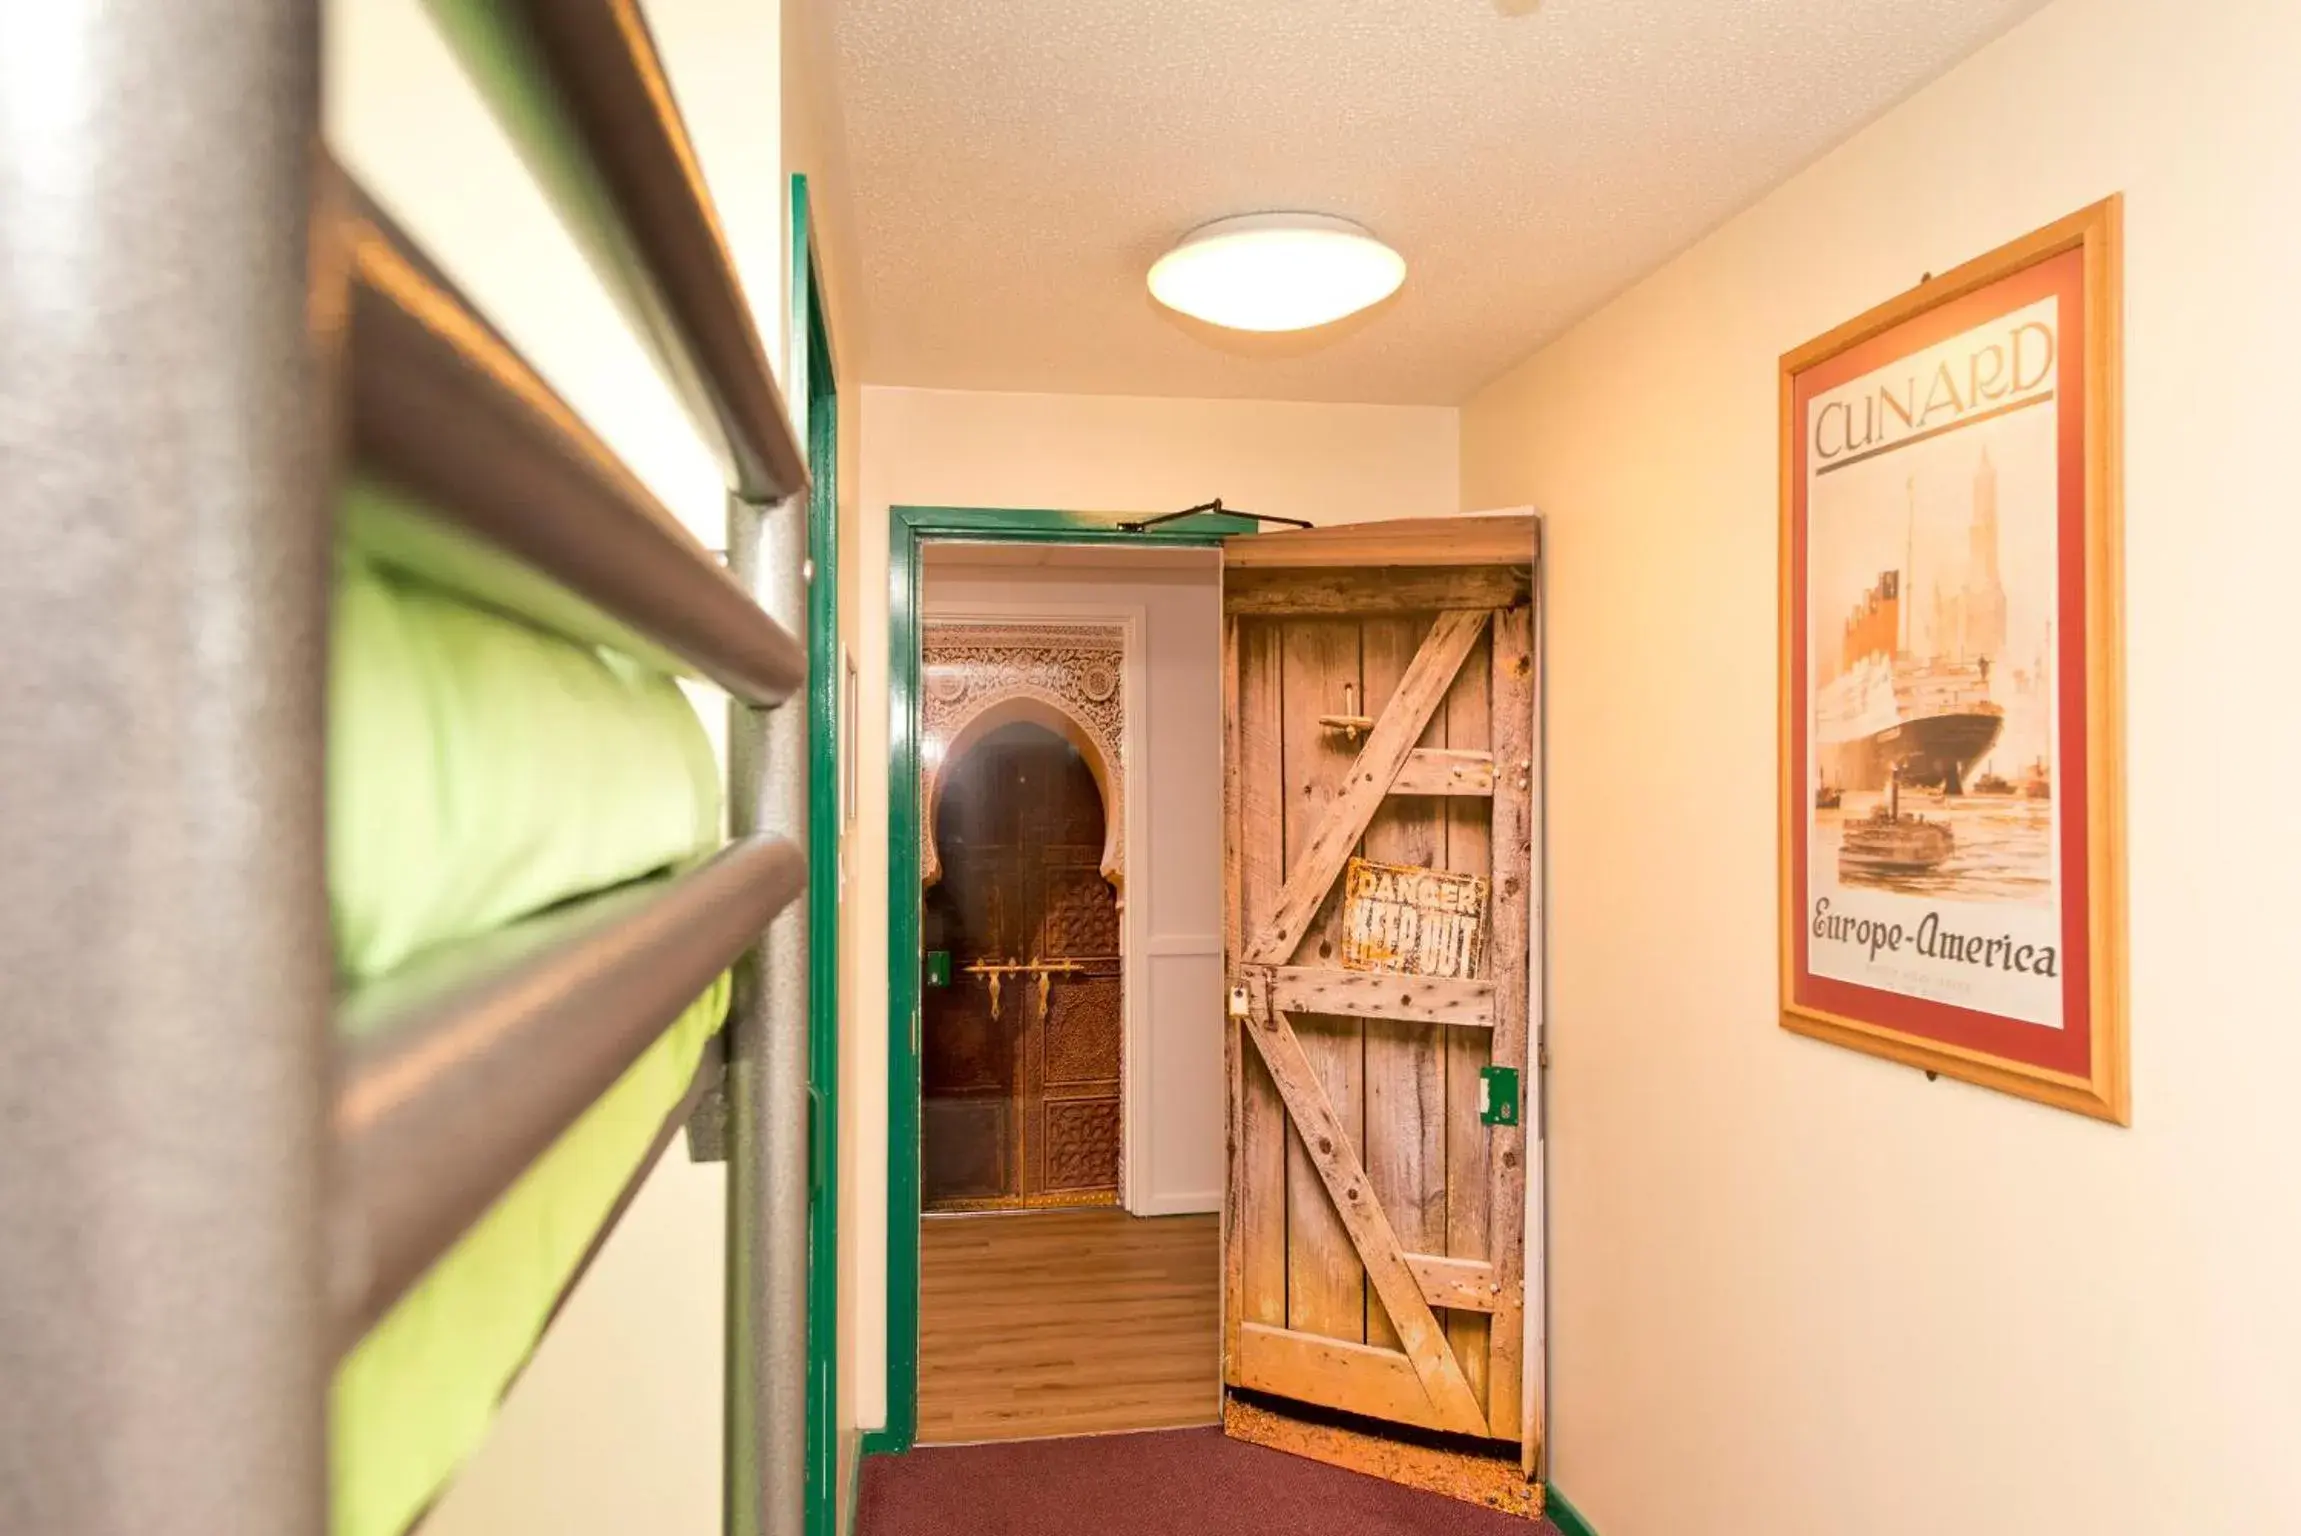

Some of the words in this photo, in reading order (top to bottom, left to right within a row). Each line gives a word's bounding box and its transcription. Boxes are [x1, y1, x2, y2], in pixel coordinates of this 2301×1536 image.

[1815, 321, 2054, 459] CUNARD
[1358, 870, 1477, 914] DANGER
[1350, 898, 1417, 968] KEEP
[1420, 914, 1478, 979] OUT
[1812, 896, 2058, 978] Europe-America
